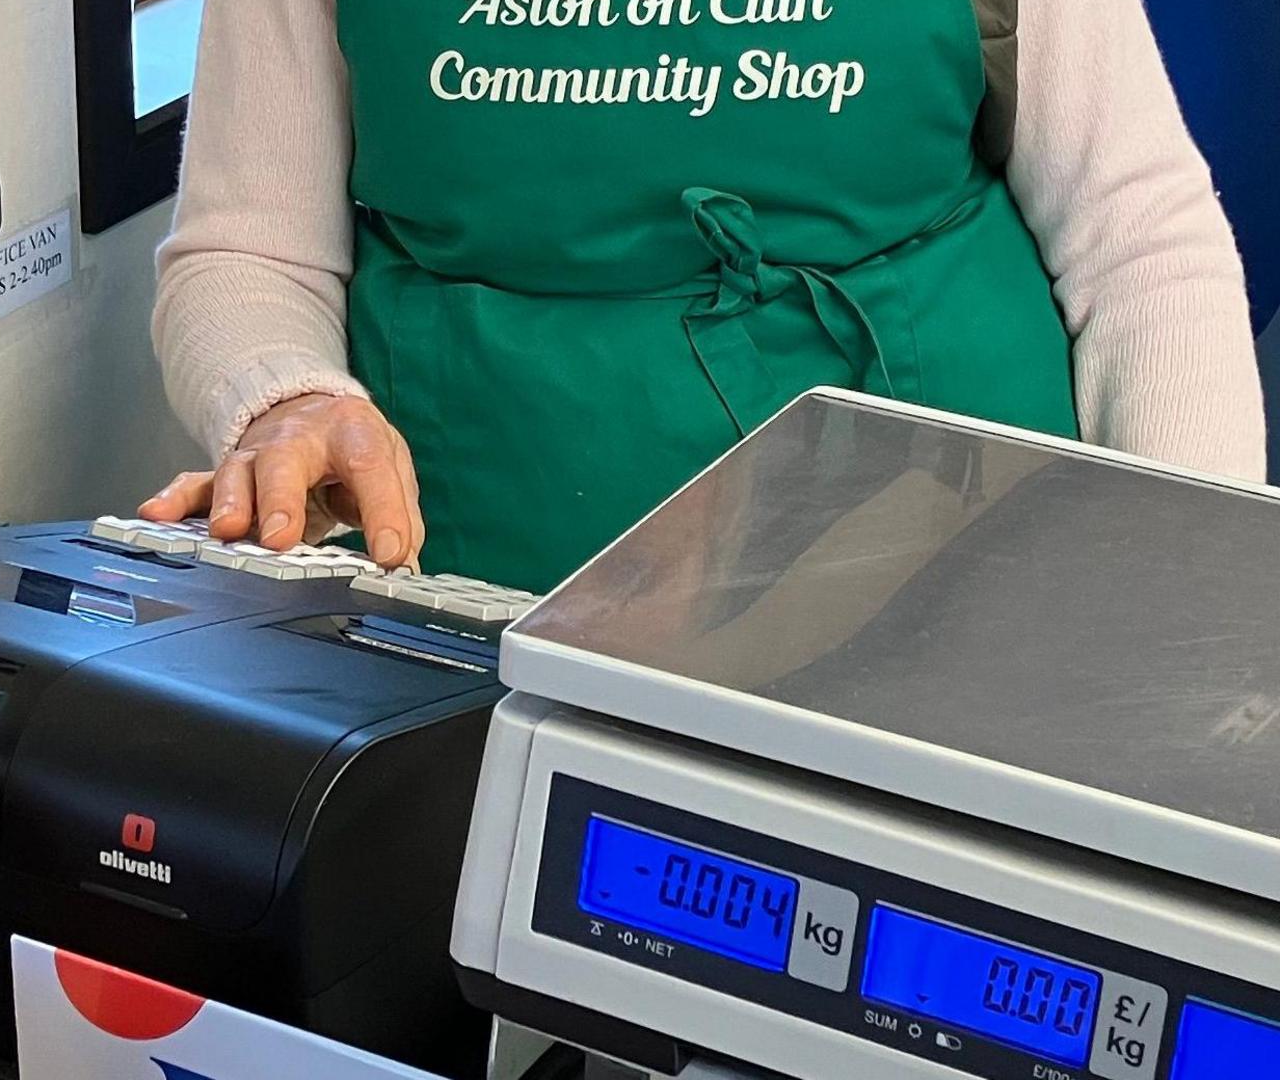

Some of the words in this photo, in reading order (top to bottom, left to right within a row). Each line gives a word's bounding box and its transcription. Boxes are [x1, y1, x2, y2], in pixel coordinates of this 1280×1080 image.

[429, 49, 722, 116] Community
[732, 49, 865, 113] Shop
[31, 223, 58, 251] VAN
[10, 251, 62, 290] 2-2.40pm
[99, 849, 172, 884] olivetti
[644, 938, 675, 960] NET
[803, 910, 845, 957] kg
[982, 955, 1092, 1036] 0.00
[1113, 993, 1152, 1027] £/
[863, 1008, 898, 1033] SUM
[1106, 1026, 1145, 1067] kg
